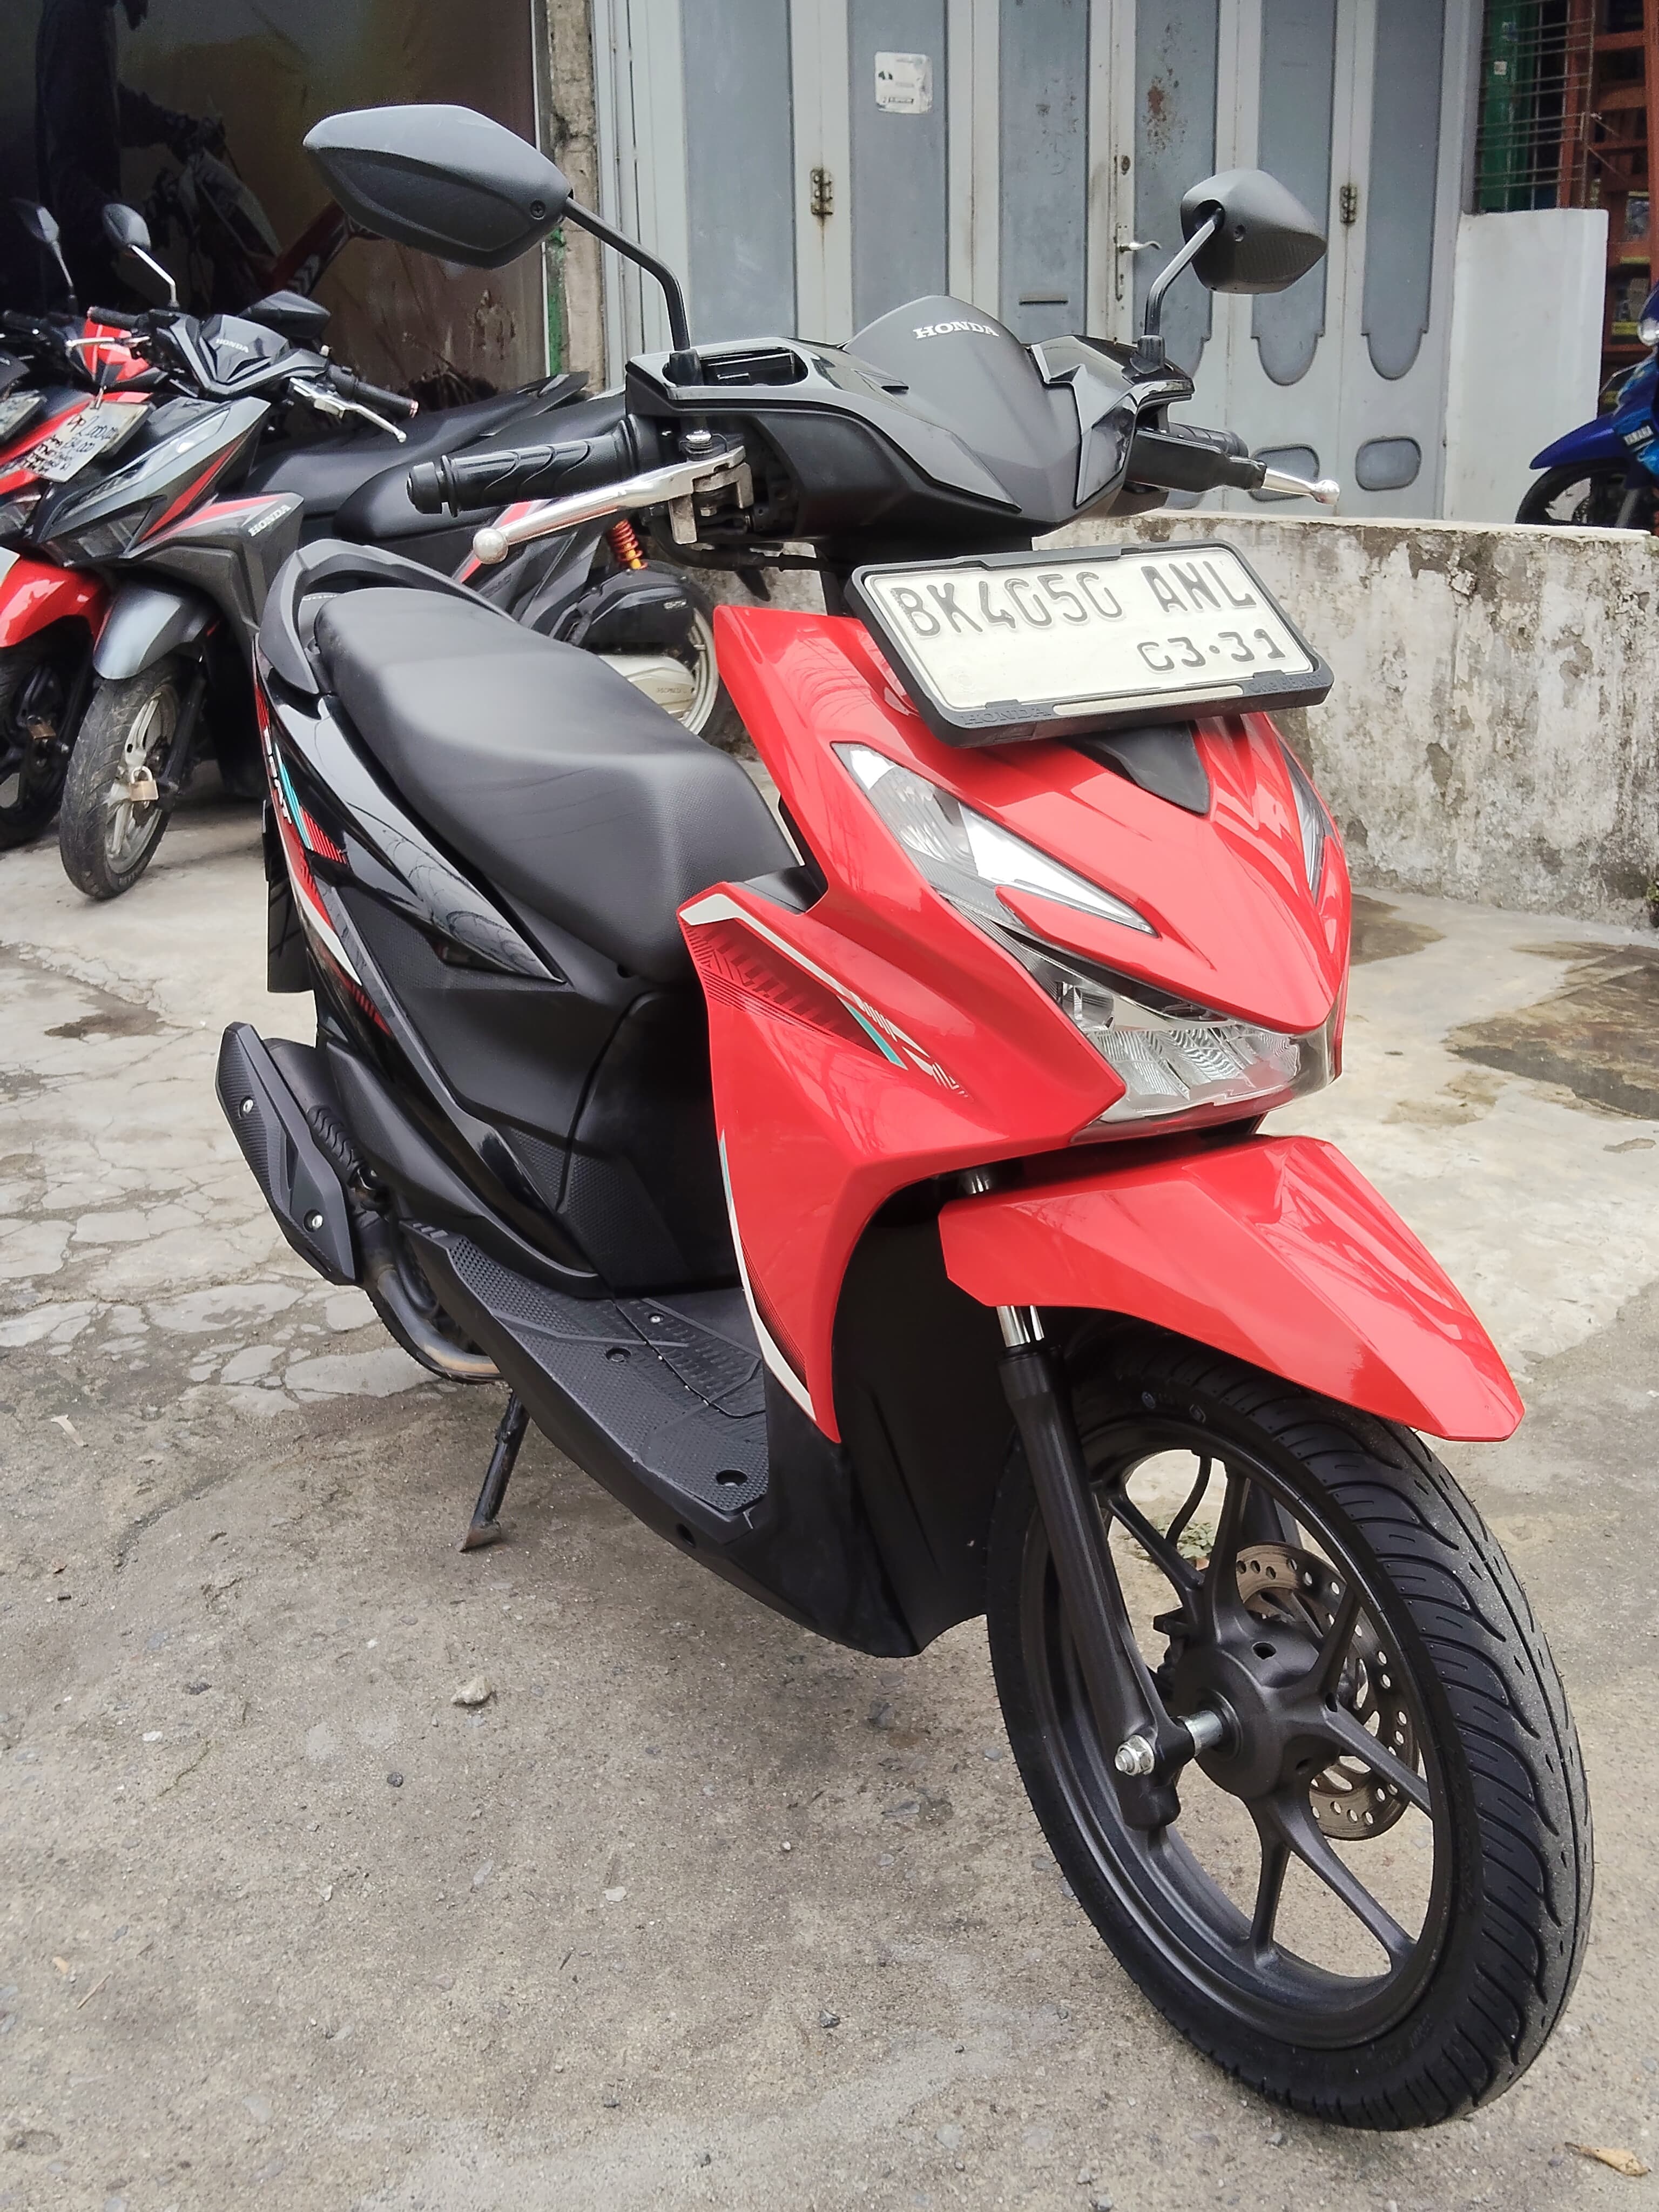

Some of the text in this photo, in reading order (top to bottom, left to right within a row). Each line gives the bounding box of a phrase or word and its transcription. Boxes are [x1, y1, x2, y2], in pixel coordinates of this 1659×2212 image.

[913, 321, 999, 339] HONDA
[216, 339, 249, 353] HONDA
[248, 504, 291, 537] HONDA
[1141, 561, 1257, 613] ANL
[959, 707, 1052, 725] HONDA
